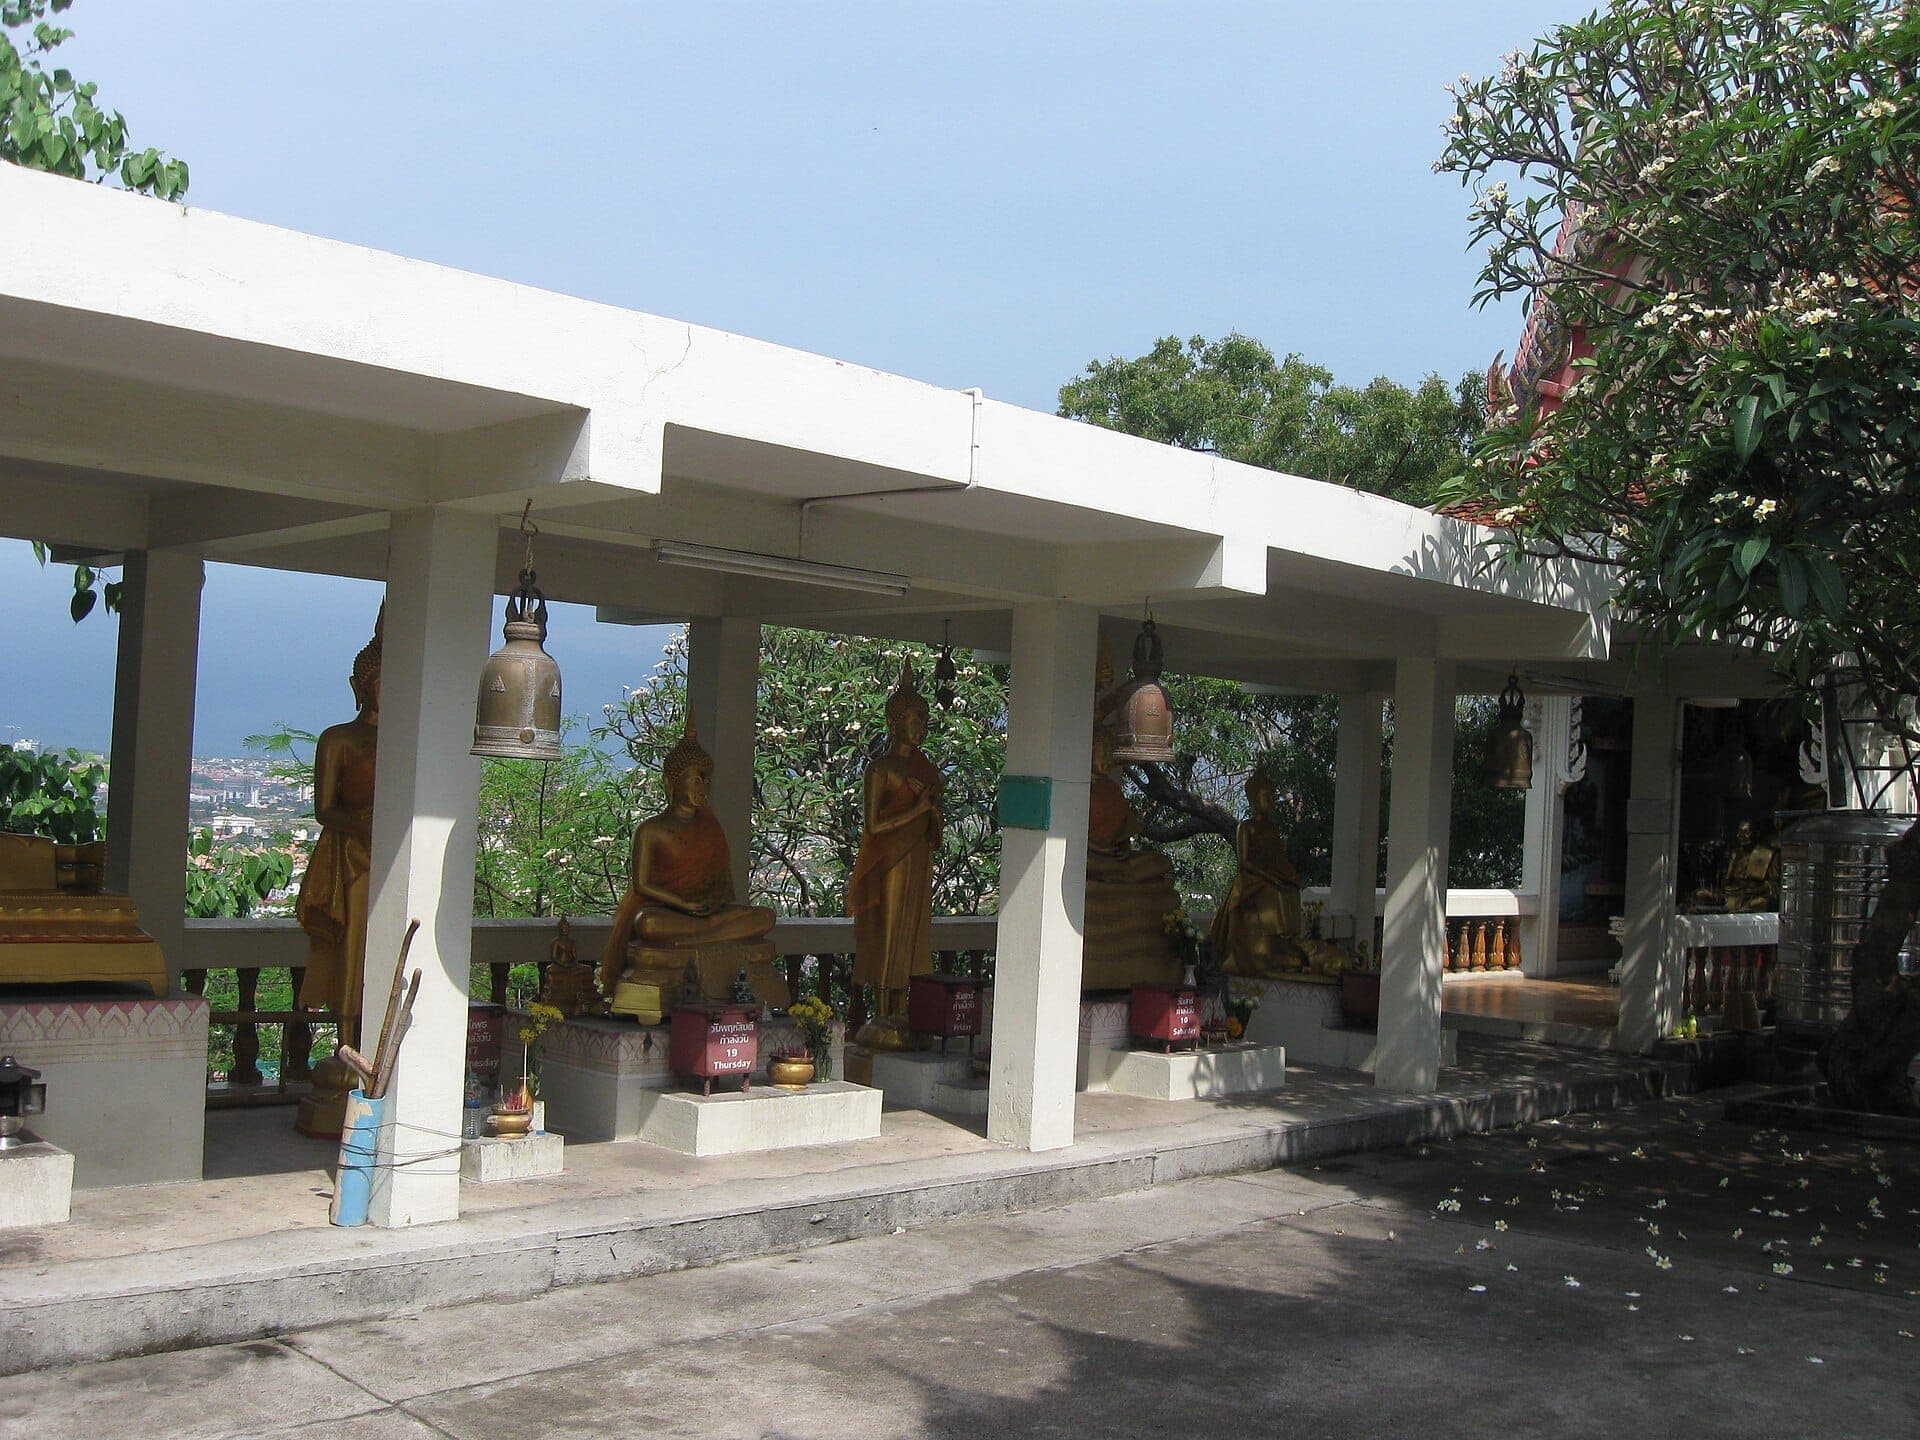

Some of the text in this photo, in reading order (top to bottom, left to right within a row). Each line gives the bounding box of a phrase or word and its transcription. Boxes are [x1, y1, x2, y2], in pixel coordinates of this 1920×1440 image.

[955, 1013, 966, 1021] 21
[1180, 1017, 1189, 1025] 10
[720, 1034, 749, 1045] กำลังวัน
[726, 1048, 738, 1057] 19
[713, 1059, 752, 1070] Thursday
